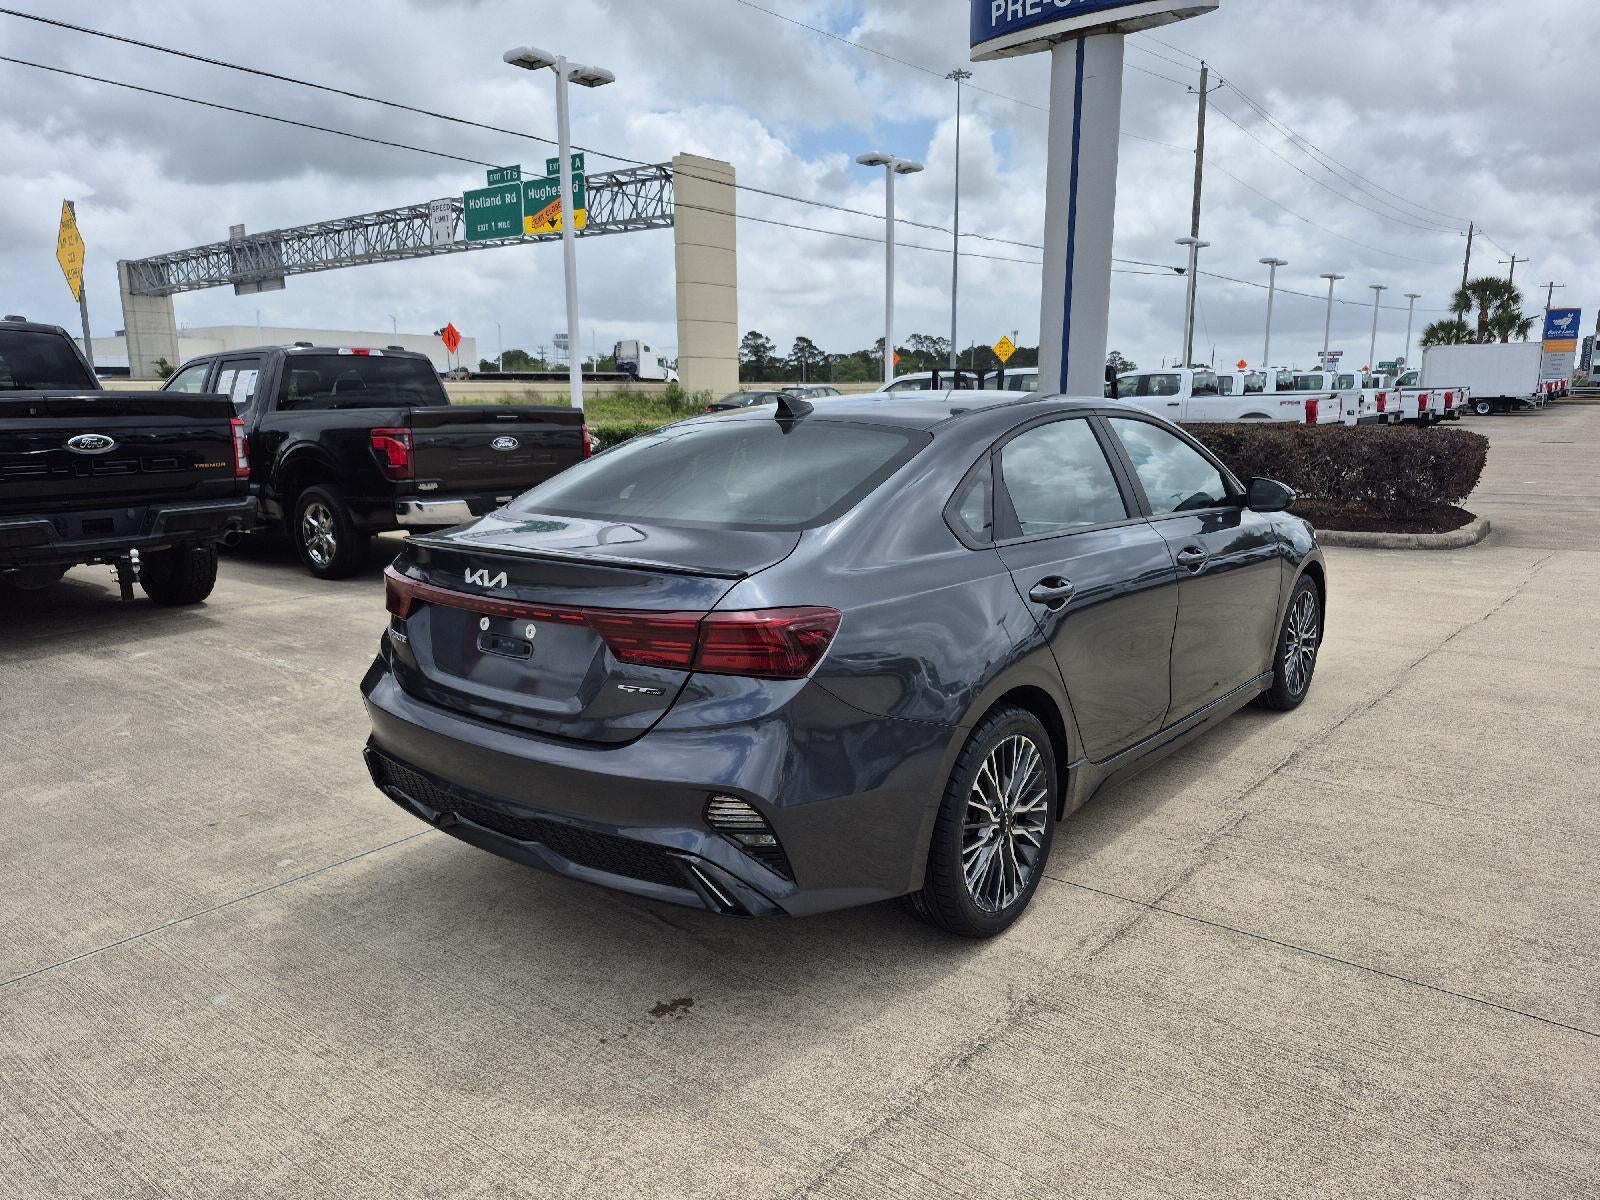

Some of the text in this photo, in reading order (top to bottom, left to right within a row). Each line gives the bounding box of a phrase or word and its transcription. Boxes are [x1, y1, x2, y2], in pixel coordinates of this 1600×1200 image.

[489, 173, 501, 182] EXIT
[528, 184, 562, 201] Hughes
[469, 191, 517, 210] Holland Rd
[432, 203, 451, 213] SPEED
[545, 201, 562, 217] CLOSE
[434, 214, 449, 224] LIMIT
[477, 220, 511, 232] EXIT 1 MILE
[79, 437, 104, 449] Ford
[497, 437, 515, 448] Ford
[194, 461, 227, 469] TREMOR
[464, 567, 508, 589] KIA
